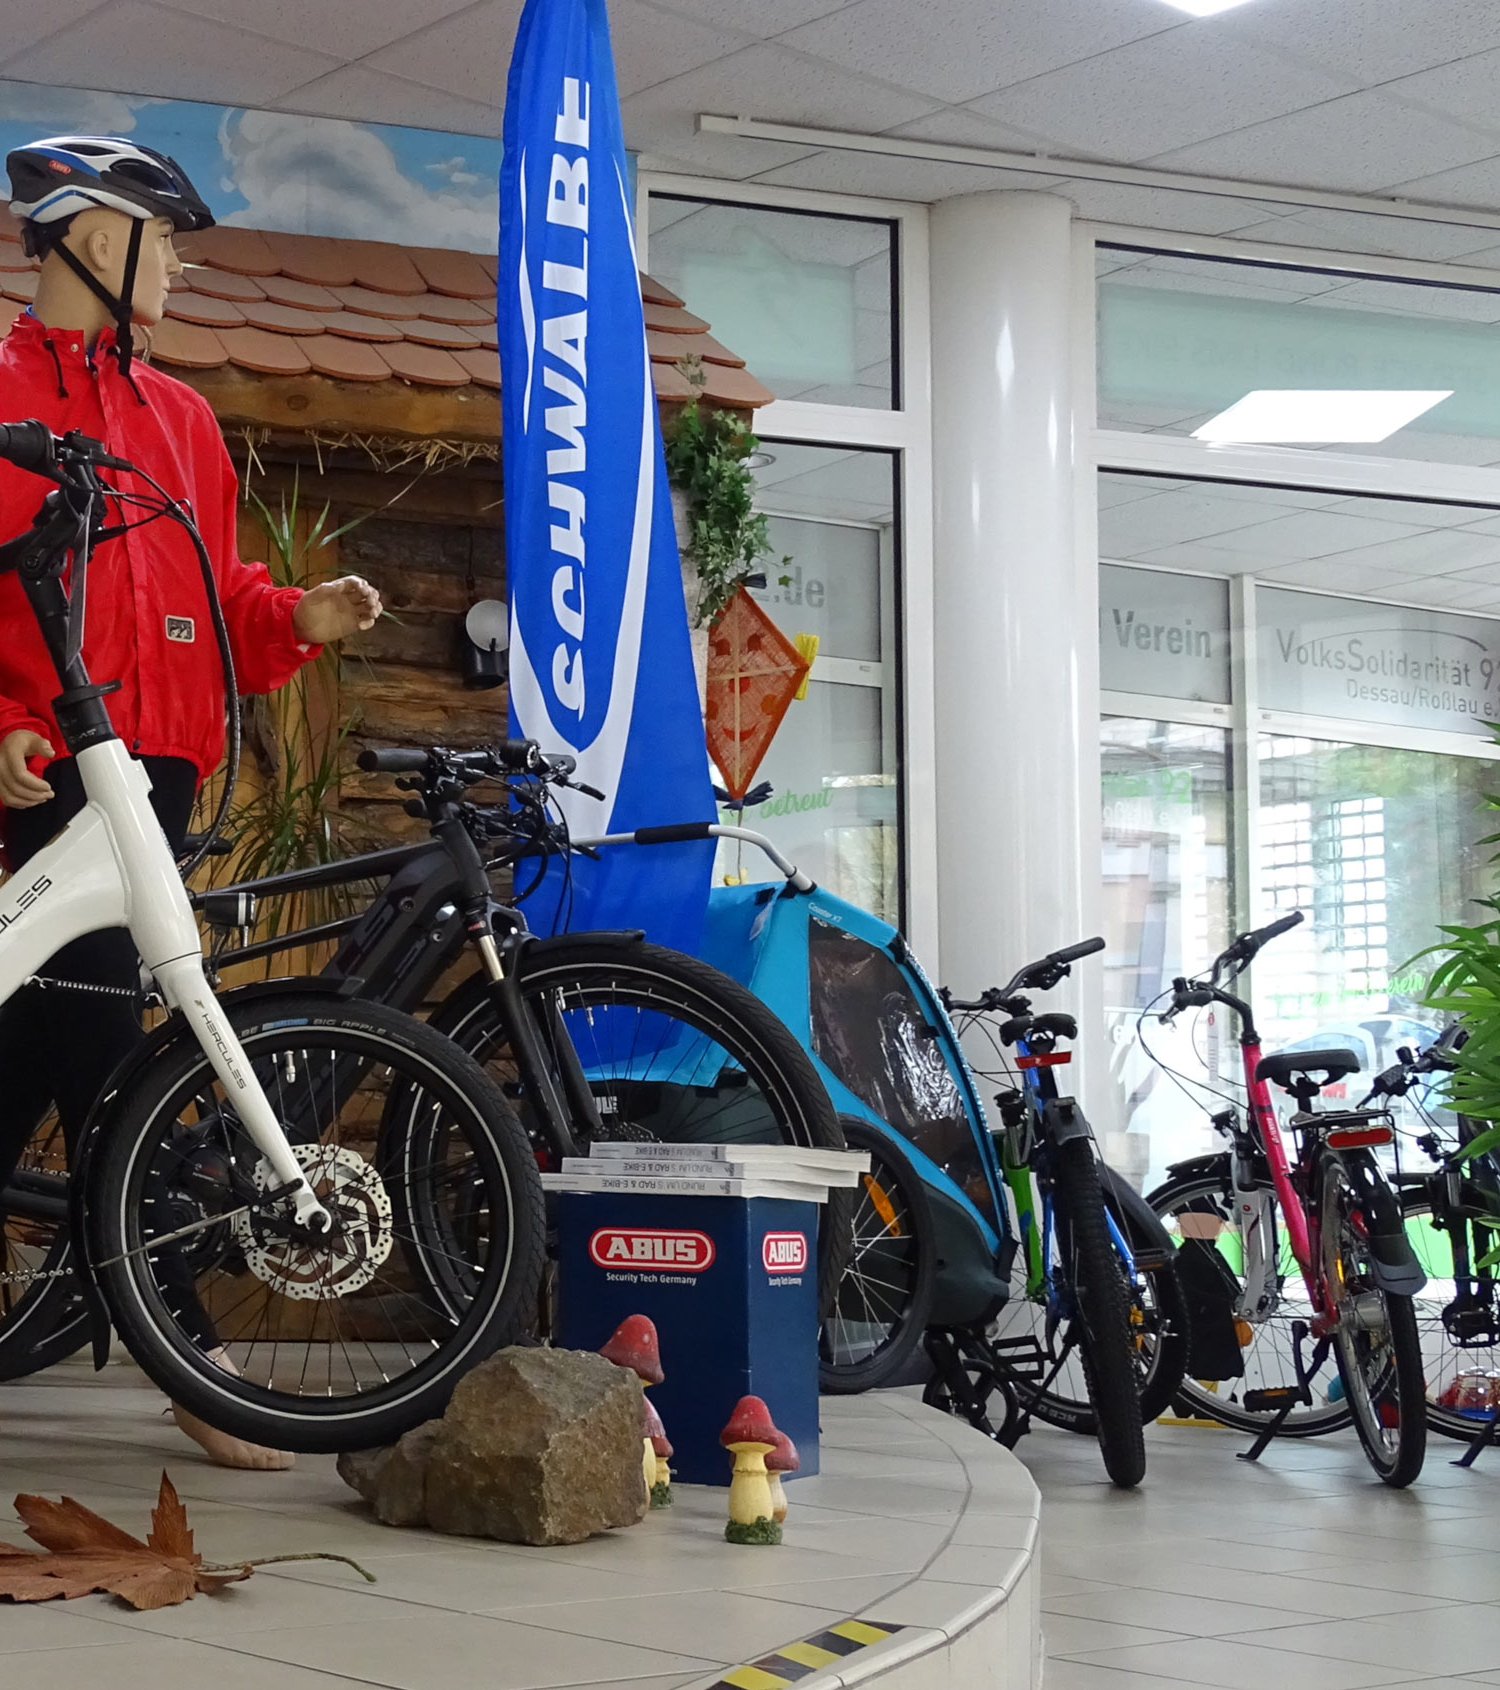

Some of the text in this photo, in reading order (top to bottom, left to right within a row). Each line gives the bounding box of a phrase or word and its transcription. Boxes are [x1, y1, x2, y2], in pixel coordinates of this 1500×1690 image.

[543, 77, 590, 722] SCHWALBE
[1112, 608, 1212, 658] Verein
[1276, 628, 1472, 687] VolksSolidarität
[1347, 678, 1478, 714] Dessau/Roßlau
[312, 1018, 338, 1027] BIG
[341, 1020, 387, 1036] APPLE
[202, 1013, 247, 1089] HERCULES
[622, 1162, 646, 1171] E-BIKE
[655, 1163, 670, 1172] RAD
[602, 1179, 628, 1188] E-BIKE
[630, 1180, 637, 1188] &
[638, 1180, 656, 1189] RAD
[606, 1237, 697, 1262] ABUS
[768, 1241, 802, 1263] ABUS
[606, 1272, 697, 1286] Security Tech Germany
